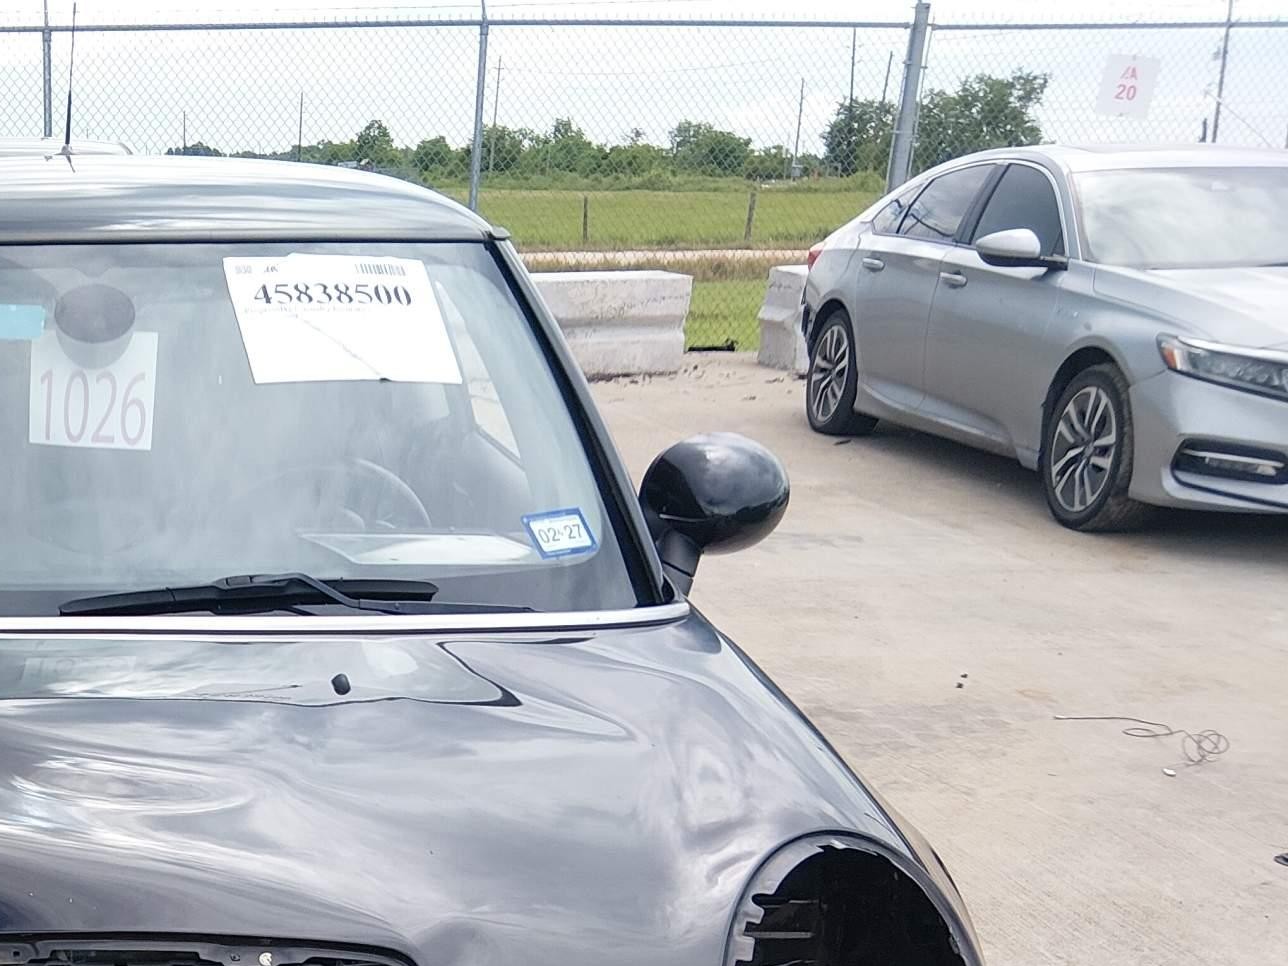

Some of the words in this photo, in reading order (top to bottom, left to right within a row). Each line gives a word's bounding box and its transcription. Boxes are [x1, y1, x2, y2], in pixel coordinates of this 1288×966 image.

[1114, 84, 1137, 101] 20
[253, 281, 412, 306] 45838500
[40, 369, 146, 446] 1026
